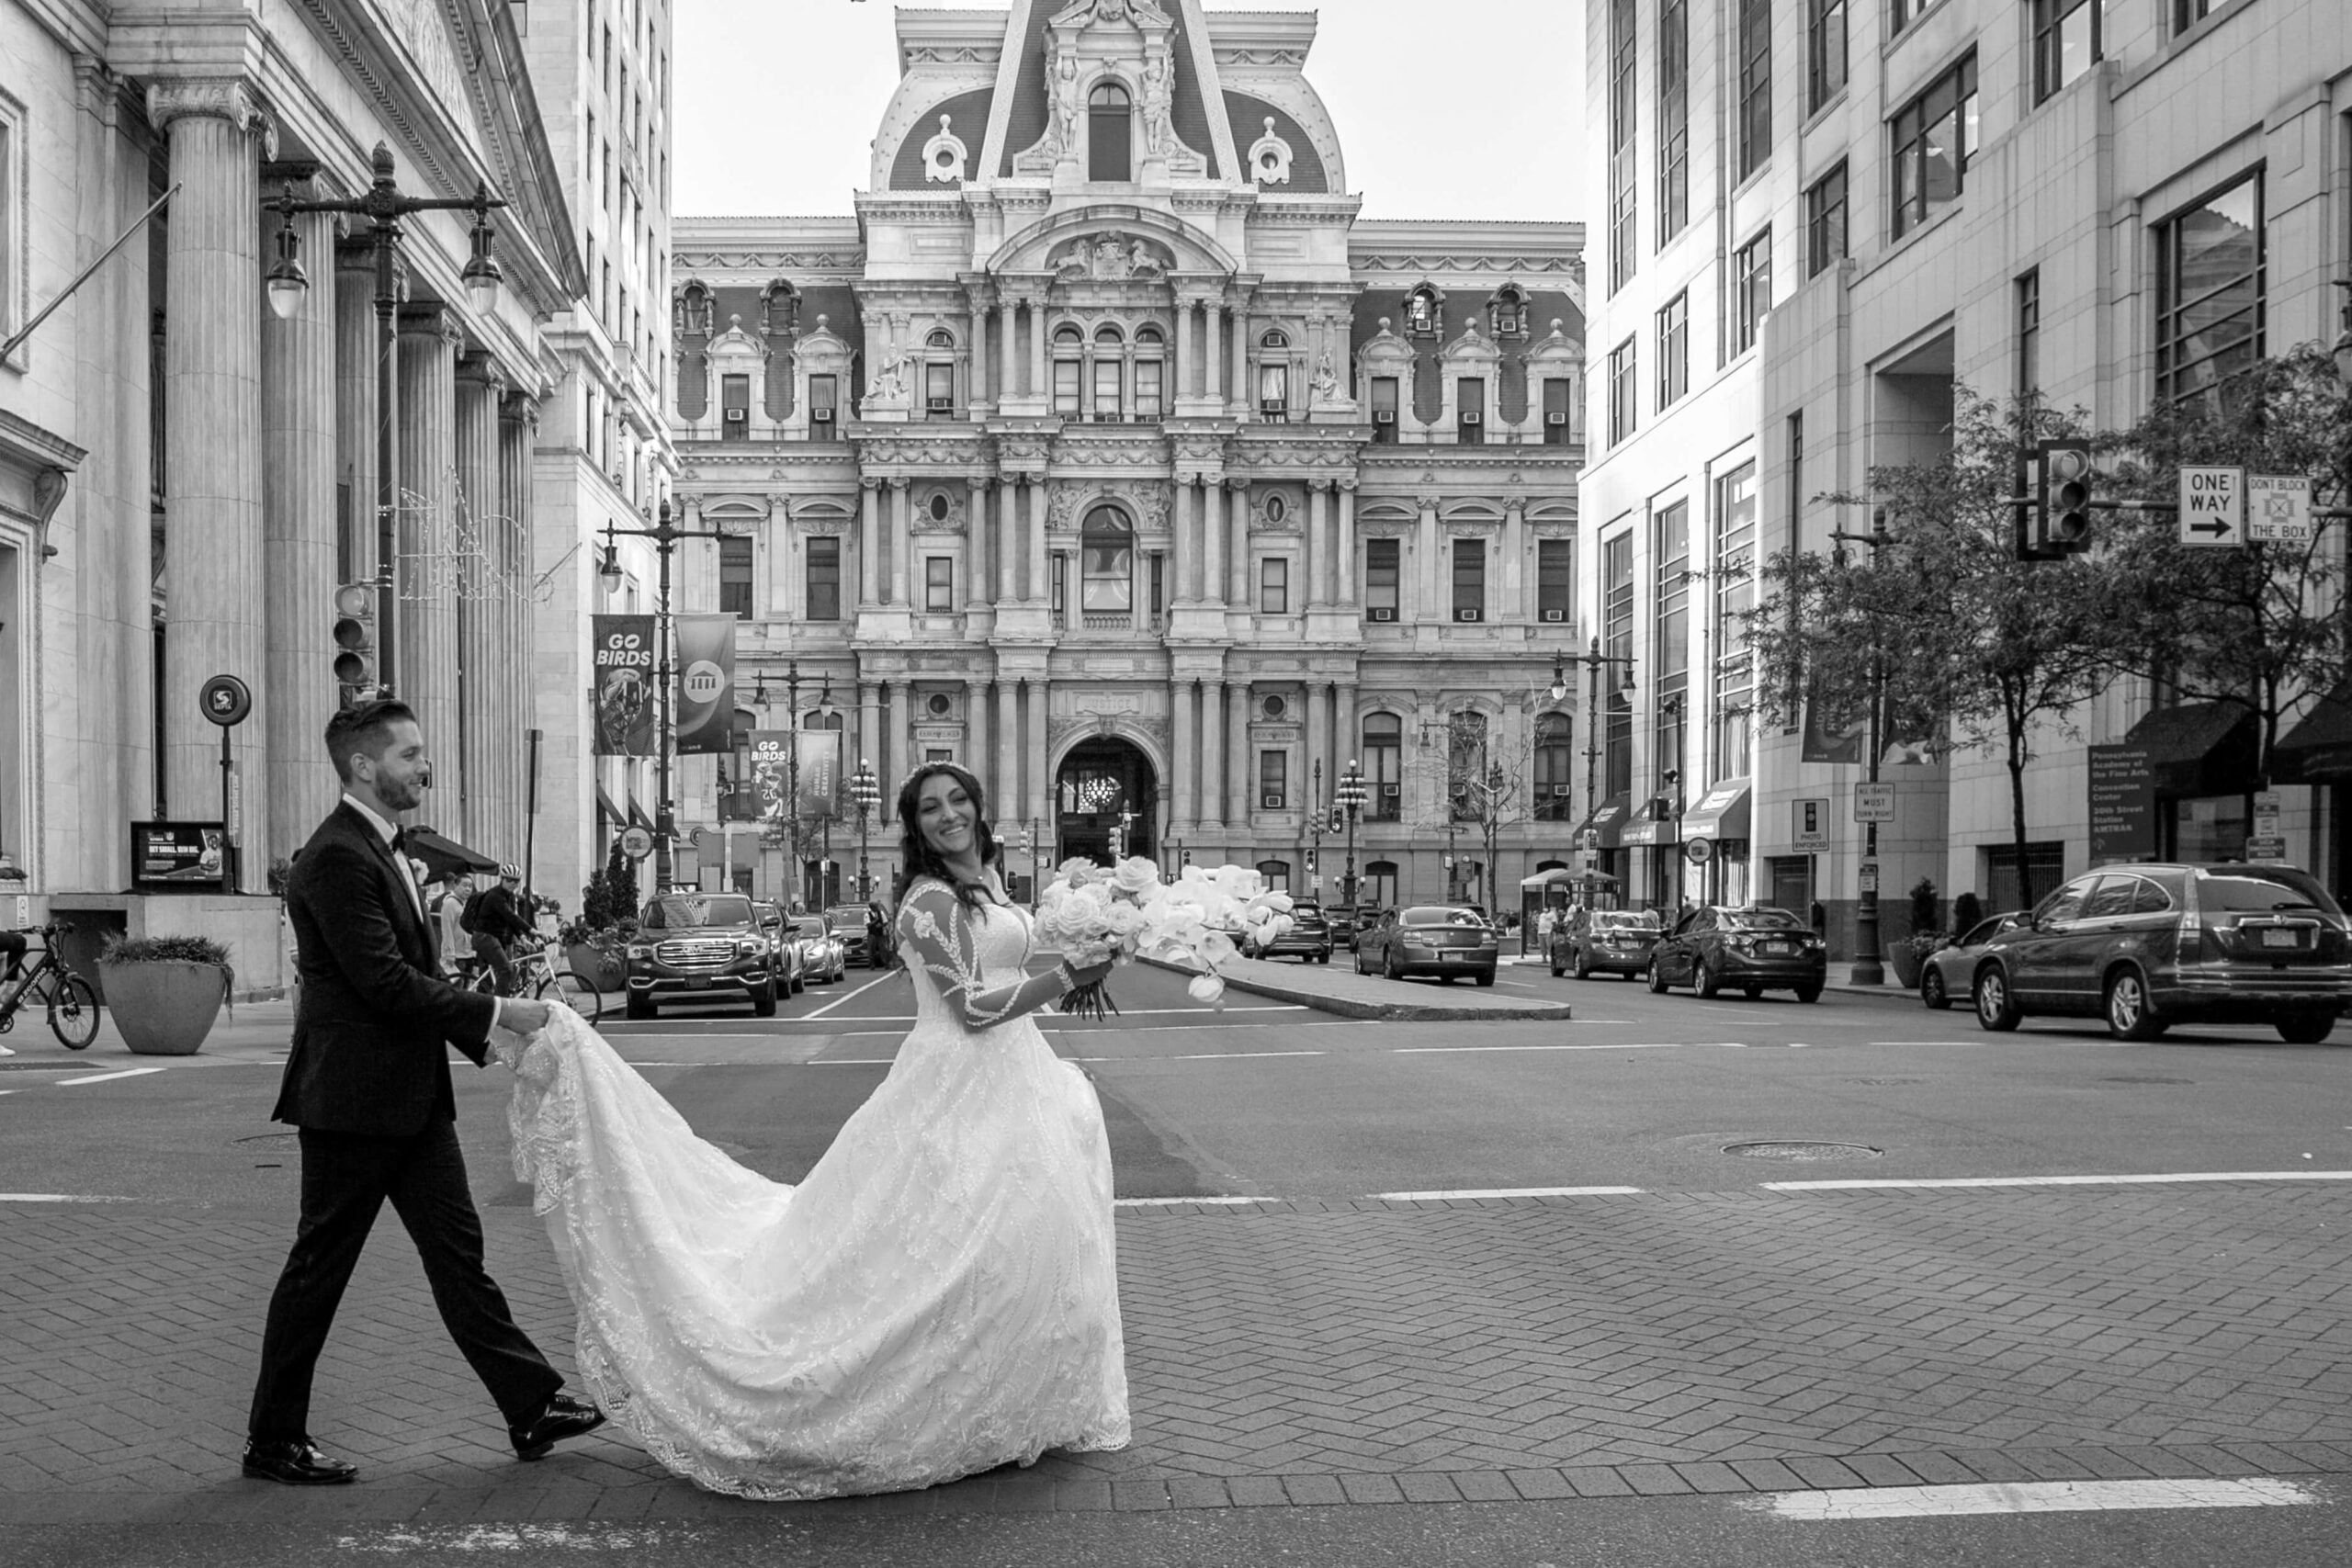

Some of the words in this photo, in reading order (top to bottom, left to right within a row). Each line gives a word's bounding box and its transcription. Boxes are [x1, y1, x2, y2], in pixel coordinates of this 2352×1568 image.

[2192, 474, 2230, 491] ONE
[2278, 479, 2307, 491] BLOCK
[2190, 495, 2231, 512] WAY
[2253, 525, 2276, 537] THE
[2281, 525, 2307, 538] BOX
[608, 634, 640, 649] GO
[596, 649, 651, 666] BIRDS
[758, 741, 779, 751] GO
[751, 750, 786, 761] BIRDS
[2092, 751, 2148, 761] Pennsylvania
[2133, 759, 2143, 767] of
[2109, 770, 2129, 778] Fine
[2131, 769, 2149, 777] Arts
[2093, 784, 2141, 792] Convention
[1863, 798, 1885, 807] MUST
[2117, 806, 2144, 814] Street
